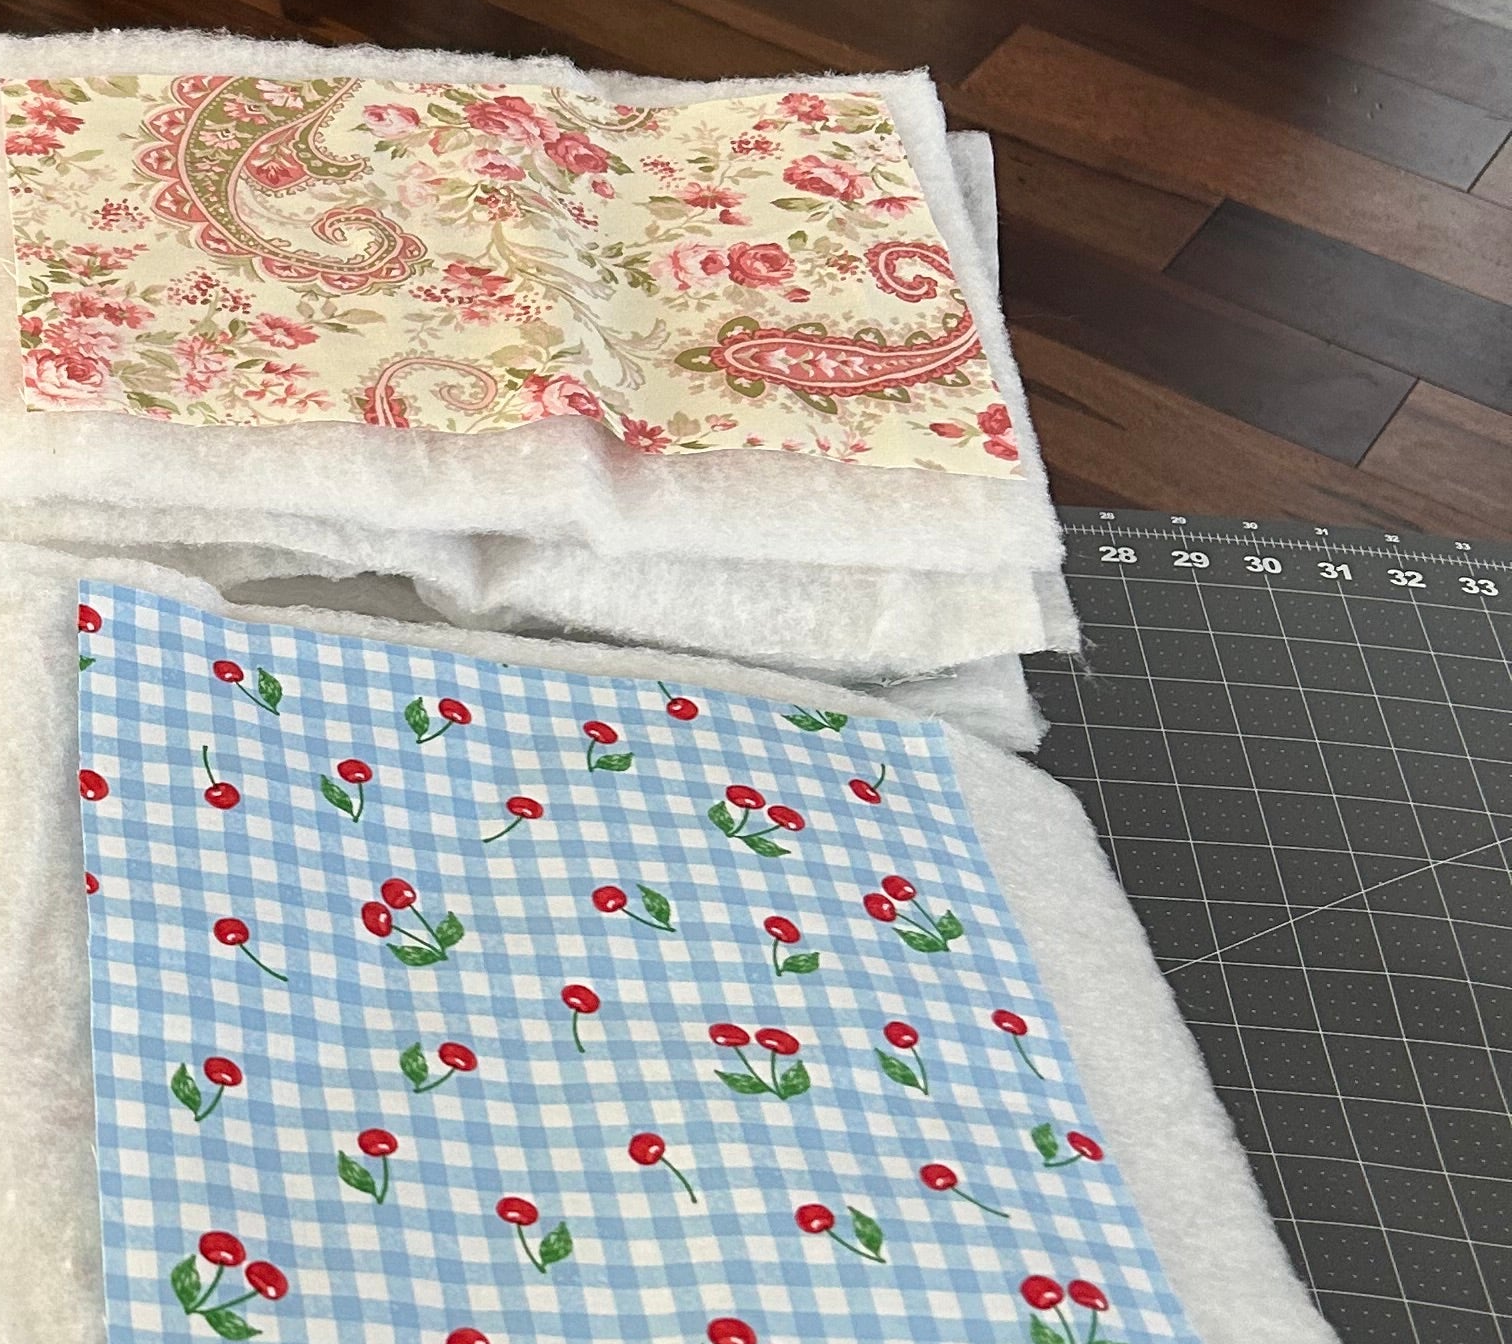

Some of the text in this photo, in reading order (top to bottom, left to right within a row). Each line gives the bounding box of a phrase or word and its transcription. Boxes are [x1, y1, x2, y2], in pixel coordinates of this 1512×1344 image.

[1242, 521, 1258, 530] 30
[1314, 527, 1329, 536] 31
[1384, 534, 1400, 543] 32
[1454, 541, 1471, 551] 33
[1098, 545, 1499, 596] 28 29 30 31 32 33
